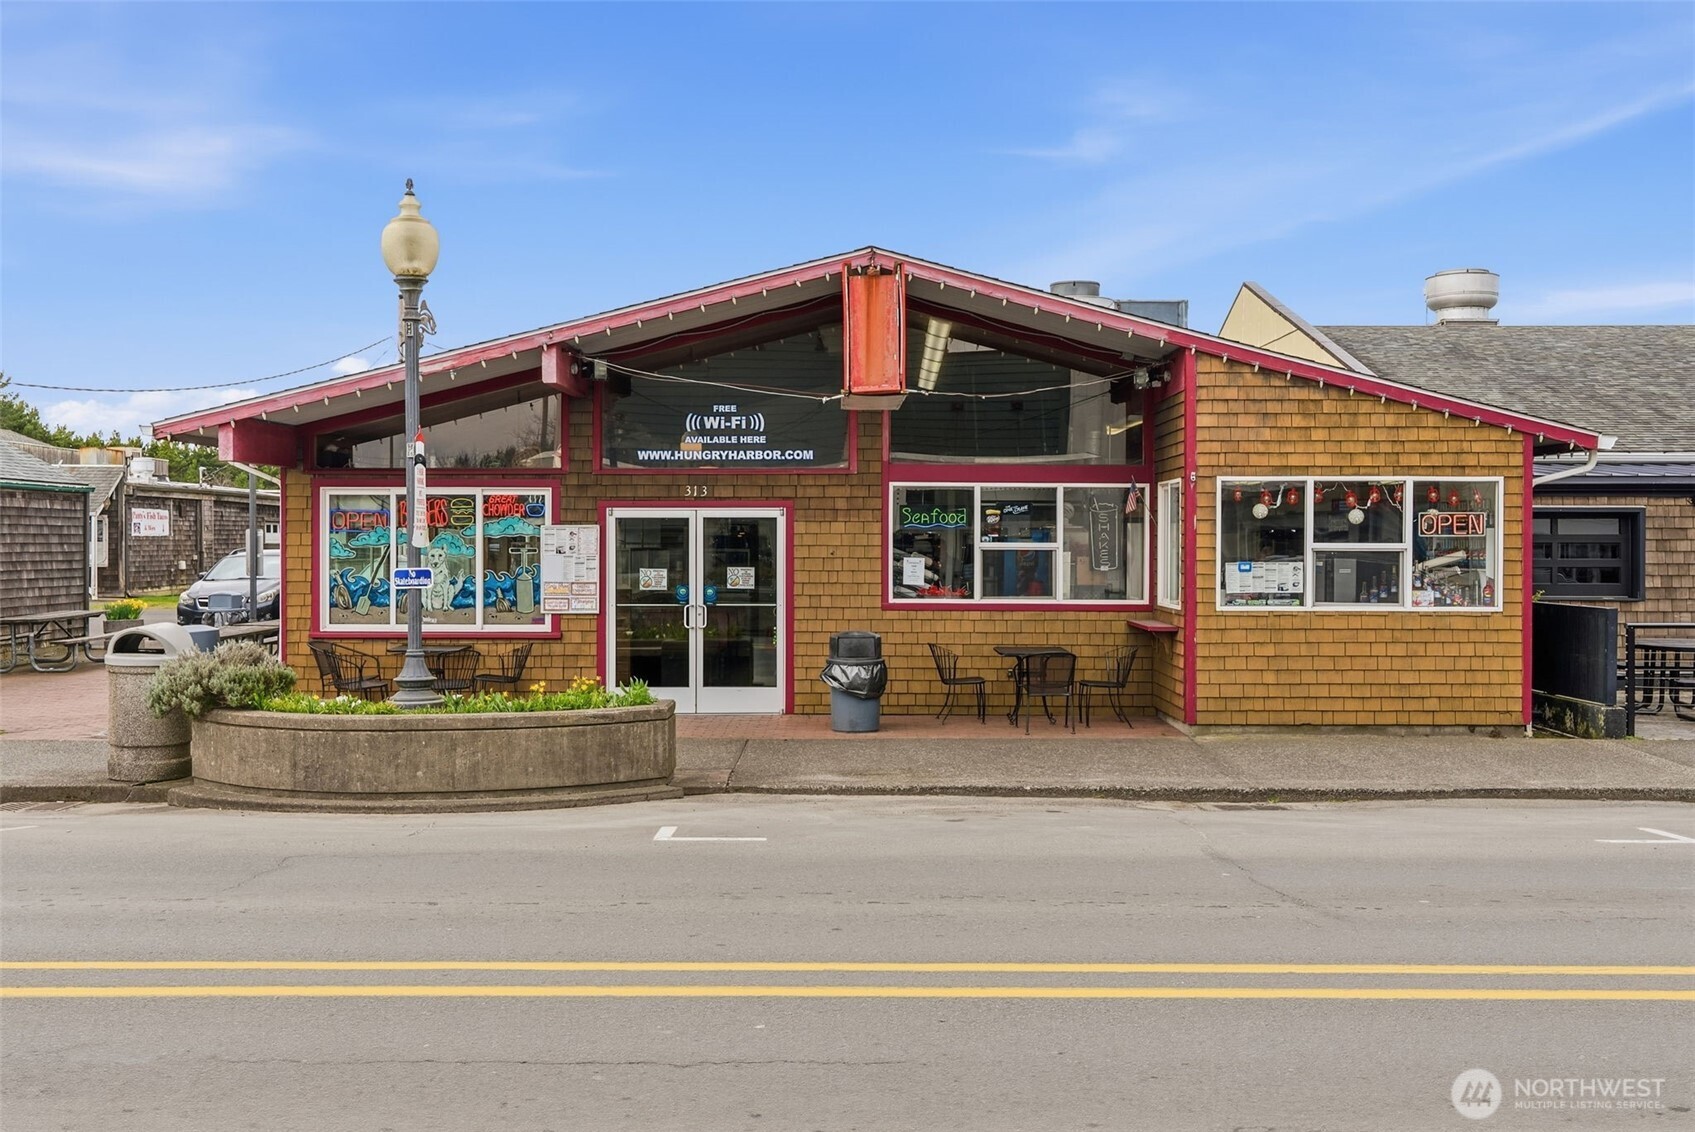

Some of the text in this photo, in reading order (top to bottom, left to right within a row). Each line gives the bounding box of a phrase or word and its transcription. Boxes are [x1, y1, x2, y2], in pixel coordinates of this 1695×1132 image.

[712, 404, 738, 413] FREE
[703, 416, 747, 430] Wi-Fi
[684, 435, 767, 444] AVAILABLE HERE
[637, 450, 814, 461] WWW.HUNGRYHARBOR.COM
[684, 485, 708, 497] 313
[488, 494, 519, 504] GREAT
[399, 498, 449, 528] BERS
[482, 503, 525, 517] CHOWDER
[331, 511, 388, 529] OPEN
[1421, 514, 1483, 535] OPEN
[1098, 513, 1111, 567] SHAKES
[640, 569, 652, 577] NO
[728, 568, 740, 576] NO
[394, 577, 431, 586] Skateboarding
